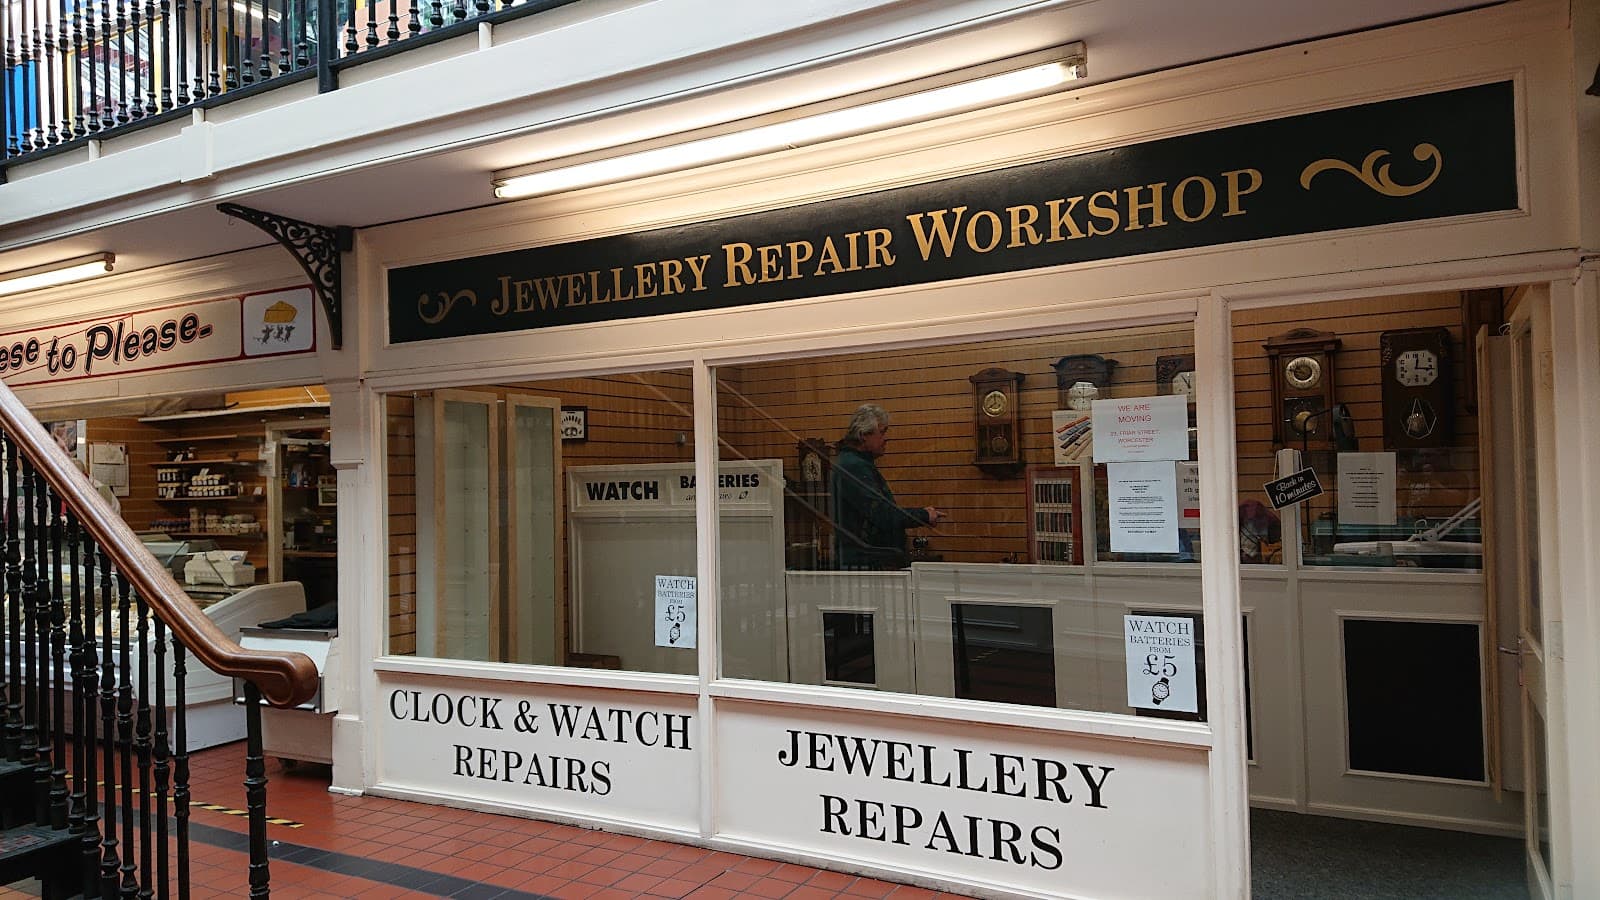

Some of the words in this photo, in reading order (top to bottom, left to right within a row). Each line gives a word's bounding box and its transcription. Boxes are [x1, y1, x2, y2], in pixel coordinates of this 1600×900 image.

[491, 254, 711, 315] JEWELLERY
[722, 228, 896, 288] REPAIR
[906, 168, 1263, 261] WORKSHOP
[46, 336, 76, 375] to
[1118, 415, 1151, 423] MOVING
[586, 481, 659, 500] WATCH
[680, 473, 760, 489] BAERIES
[1275, 492, 1287, 505] 10
[1287, 480, 1317, 500] minutes
[1276, 477, 1297, 491] Back
[657, 579, 694, 590] WATCH
[664, 604, 686, 622] £5
[1128, 619, 1190, 635] WATCH
[1130, 635, 1191, 647] BATTERIES
[1149, 646, 1171, 654] FROM
[1142, 653, 1177, 677] £5
[389, 689, 503, 730] CLOCK
[513, 700, 539, 734] &
[547, 703, 692, 750] WATCH
[452, 744, 612, 796] REPAIRS
[778, 729, 1115, 809] JEWELLERY
[820, 794, 1063, 871] REPAIRS
